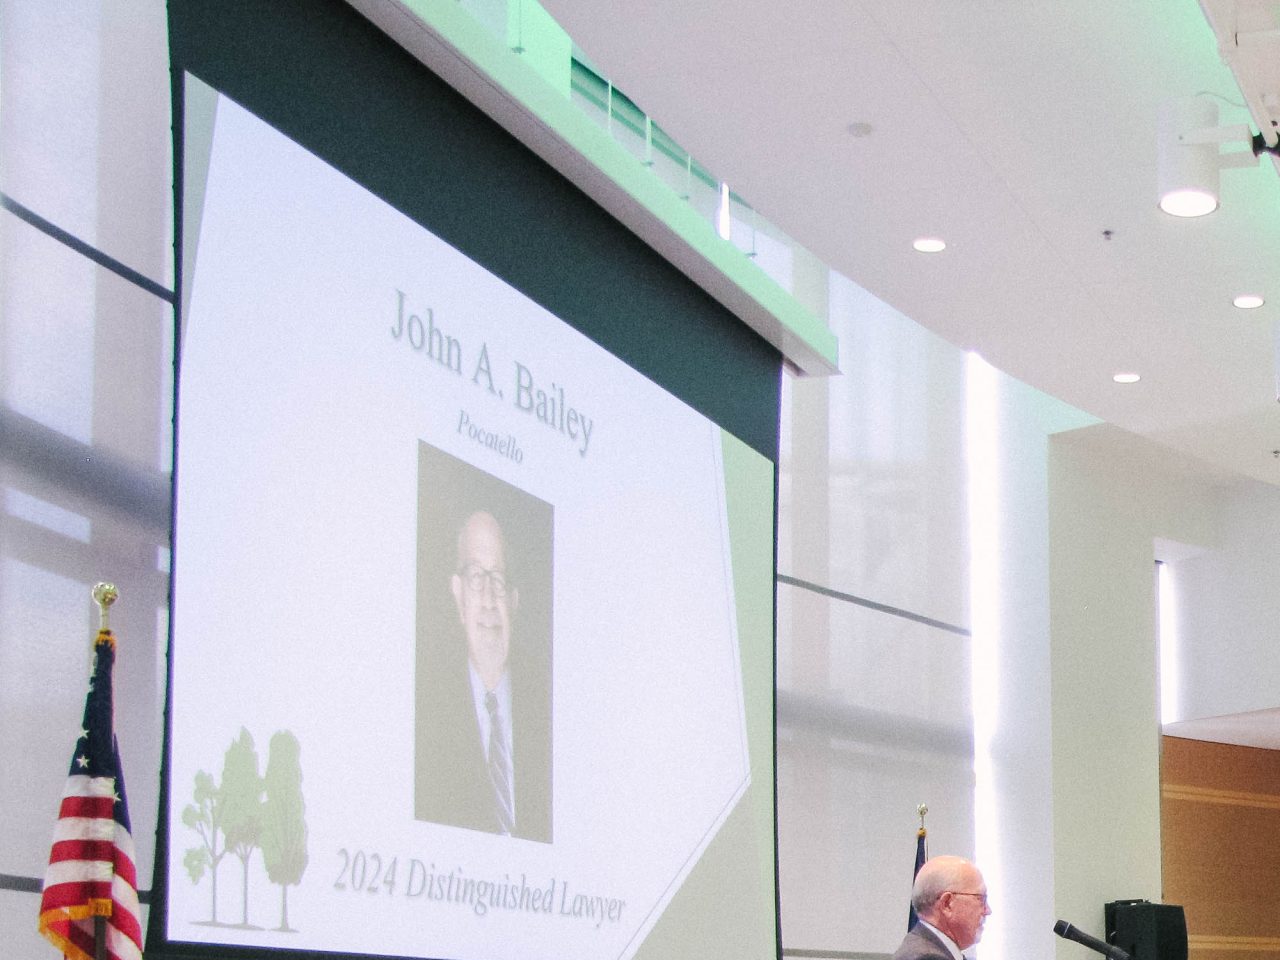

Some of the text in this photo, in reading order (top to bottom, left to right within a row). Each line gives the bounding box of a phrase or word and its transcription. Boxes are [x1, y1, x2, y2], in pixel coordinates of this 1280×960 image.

[391, 288, 594, 458] John A. Bailey
[456, 409, 524, 465] Pocatello
[333, 848, 626, 928] 2024 Distinguished Lawyer
